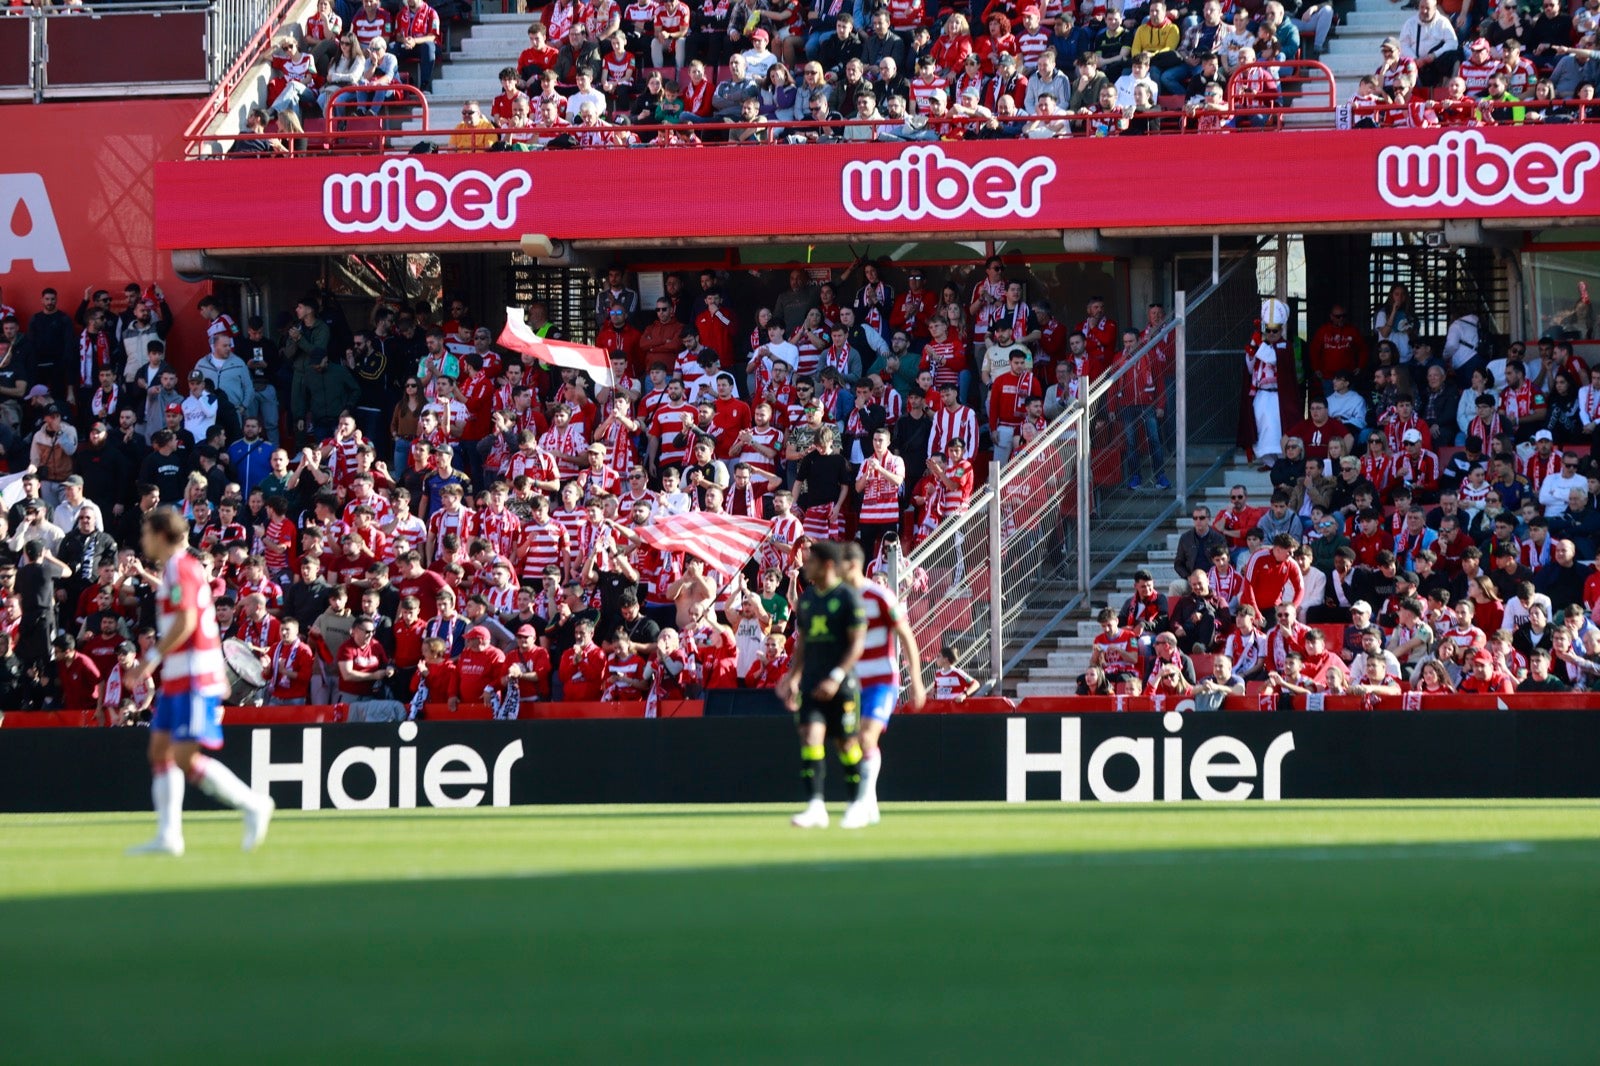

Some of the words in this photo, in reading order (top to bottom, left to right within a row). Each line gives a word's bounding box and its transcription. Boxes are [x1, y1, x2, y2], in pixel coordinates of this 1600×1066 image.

[323, 158, 532, 233] wiber
[842, 145, 1056, 220] wiber
[1378, 130, 1598, 207] wiber
[250, 722, 523, 809] Haier
[1007, 712, 1294, 803] Haier
